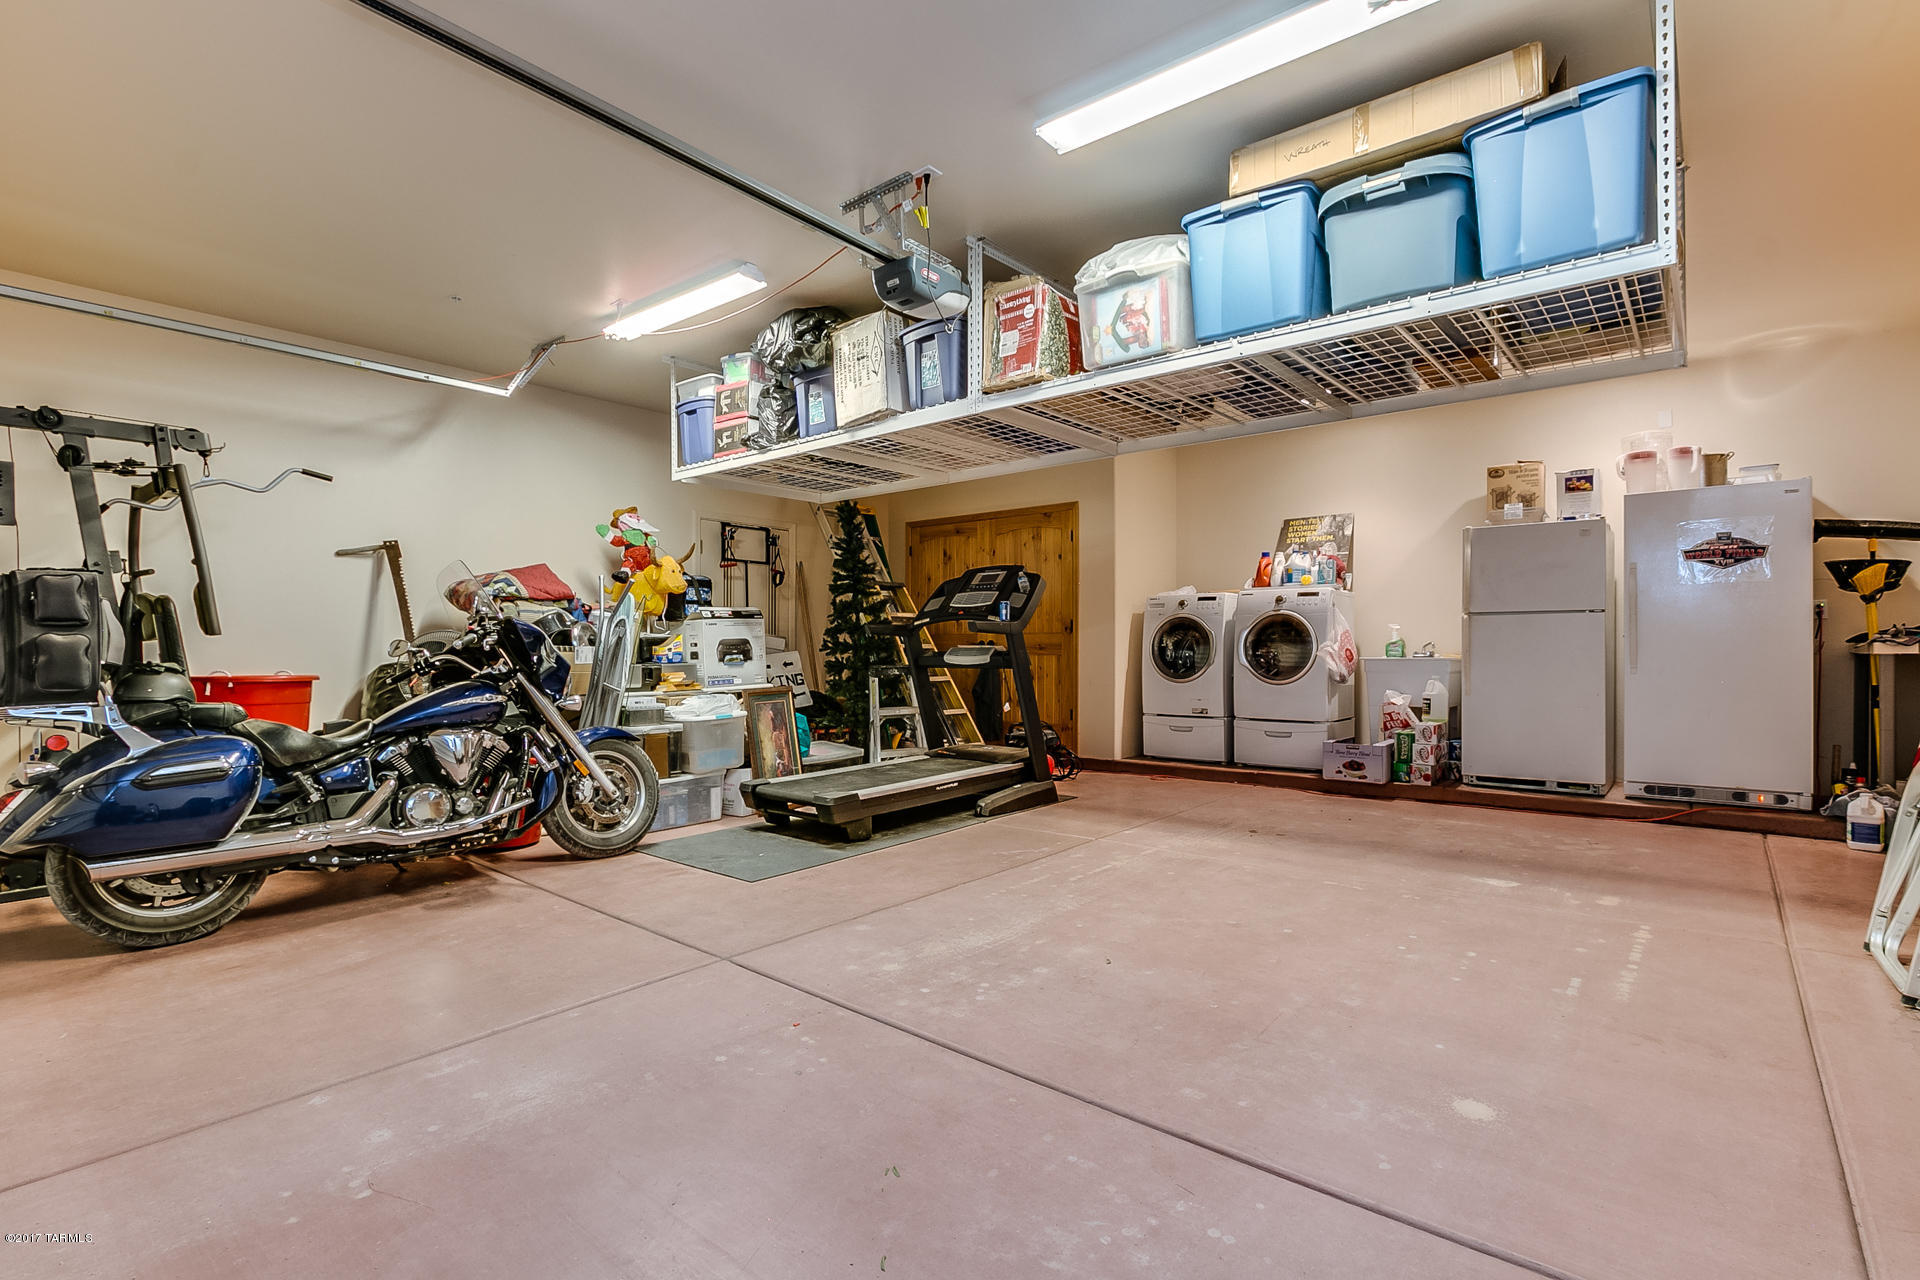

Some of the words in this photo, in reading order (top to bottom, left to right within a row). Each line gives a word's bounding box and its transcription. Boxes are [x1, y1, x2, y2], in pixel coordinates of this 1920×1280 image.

[1283, 139, 1331, 162] WREATH
[1286, 536, 1311, 544] START
[1685, 549, 1722, 559] WORLD
[1725, 547, 1765, 558] FINALS
